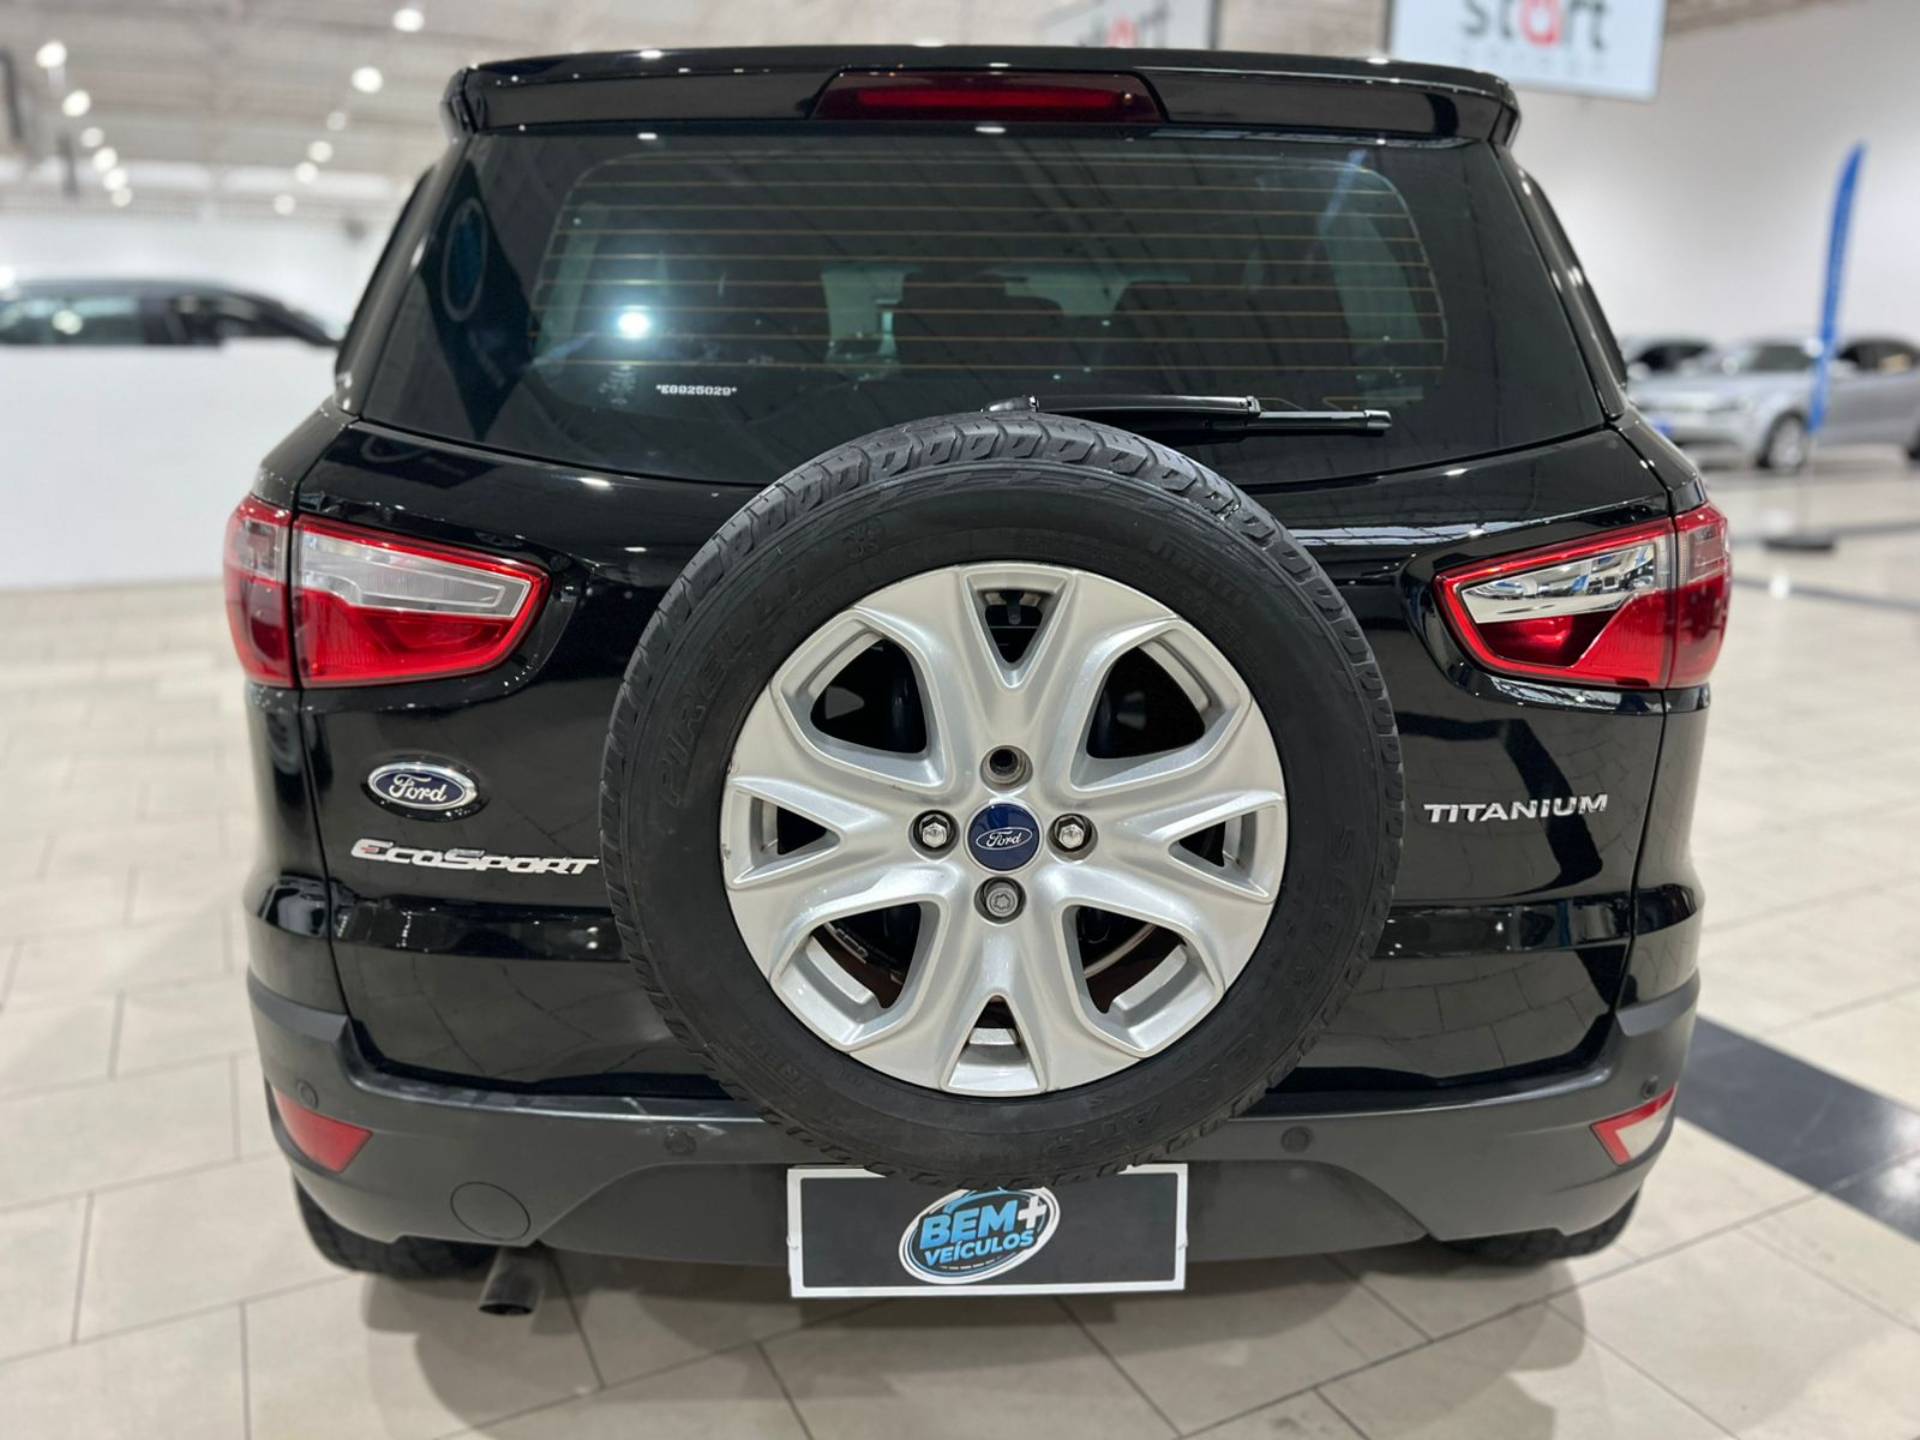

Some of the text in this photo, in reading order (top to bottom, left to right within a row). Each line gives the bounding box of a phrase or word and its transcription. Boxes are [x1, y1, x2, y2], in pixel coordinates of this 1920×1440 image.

[389, 773, 448, 802] Ford
[1423, 794, 1609, 823] TITANIUM
[986, 830, 1023, 848] Ford
[924, 1229, 1034, 1267] VEÍCULOS
